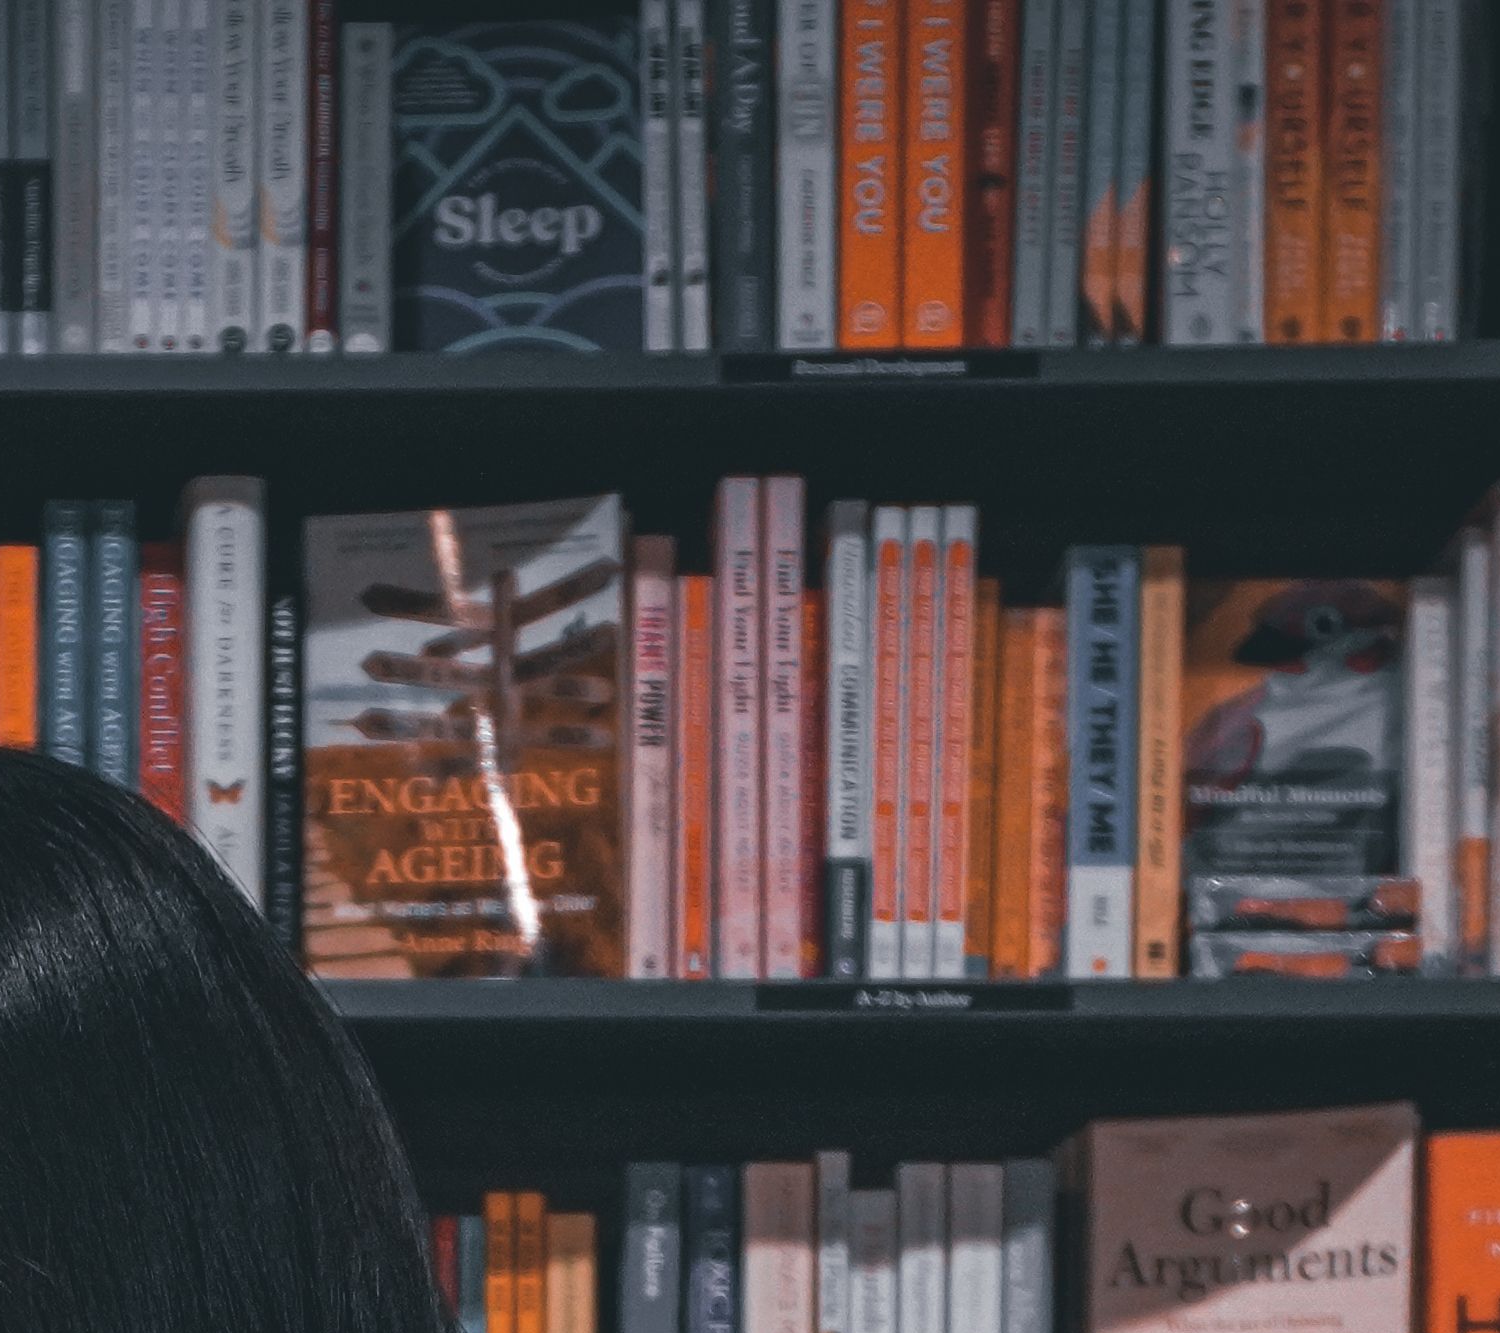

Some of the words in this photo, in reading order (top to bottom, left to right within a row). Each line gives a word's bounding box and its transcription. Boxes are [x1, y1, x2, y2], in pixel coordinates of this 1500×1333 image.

[856, 39, 885, 143] WERE
[921, 38, 952, 142] WERE
[434, 197, 599, 250] Sleep
[853, 155, 885, 235] YOU
[919, 154, 952, 234] YOU
[1203, 170, 1228, 277] HOLLY
[147, 652, 177, 774] Conflict
[218, 635, 235, 763] DARKNESS
[641, 679, 667, 748] POWER
[840, 664, 859, 841] COMMUNICATION
[1190, 786, 1278, 806] Mindful
[1285, 787, 1386, 806] Moments
[1178, 1180, 1330, 1239] Good
[643, 1223, 663, 1299] Failure
[1106, 1241, 1398, 1301] Arguments
